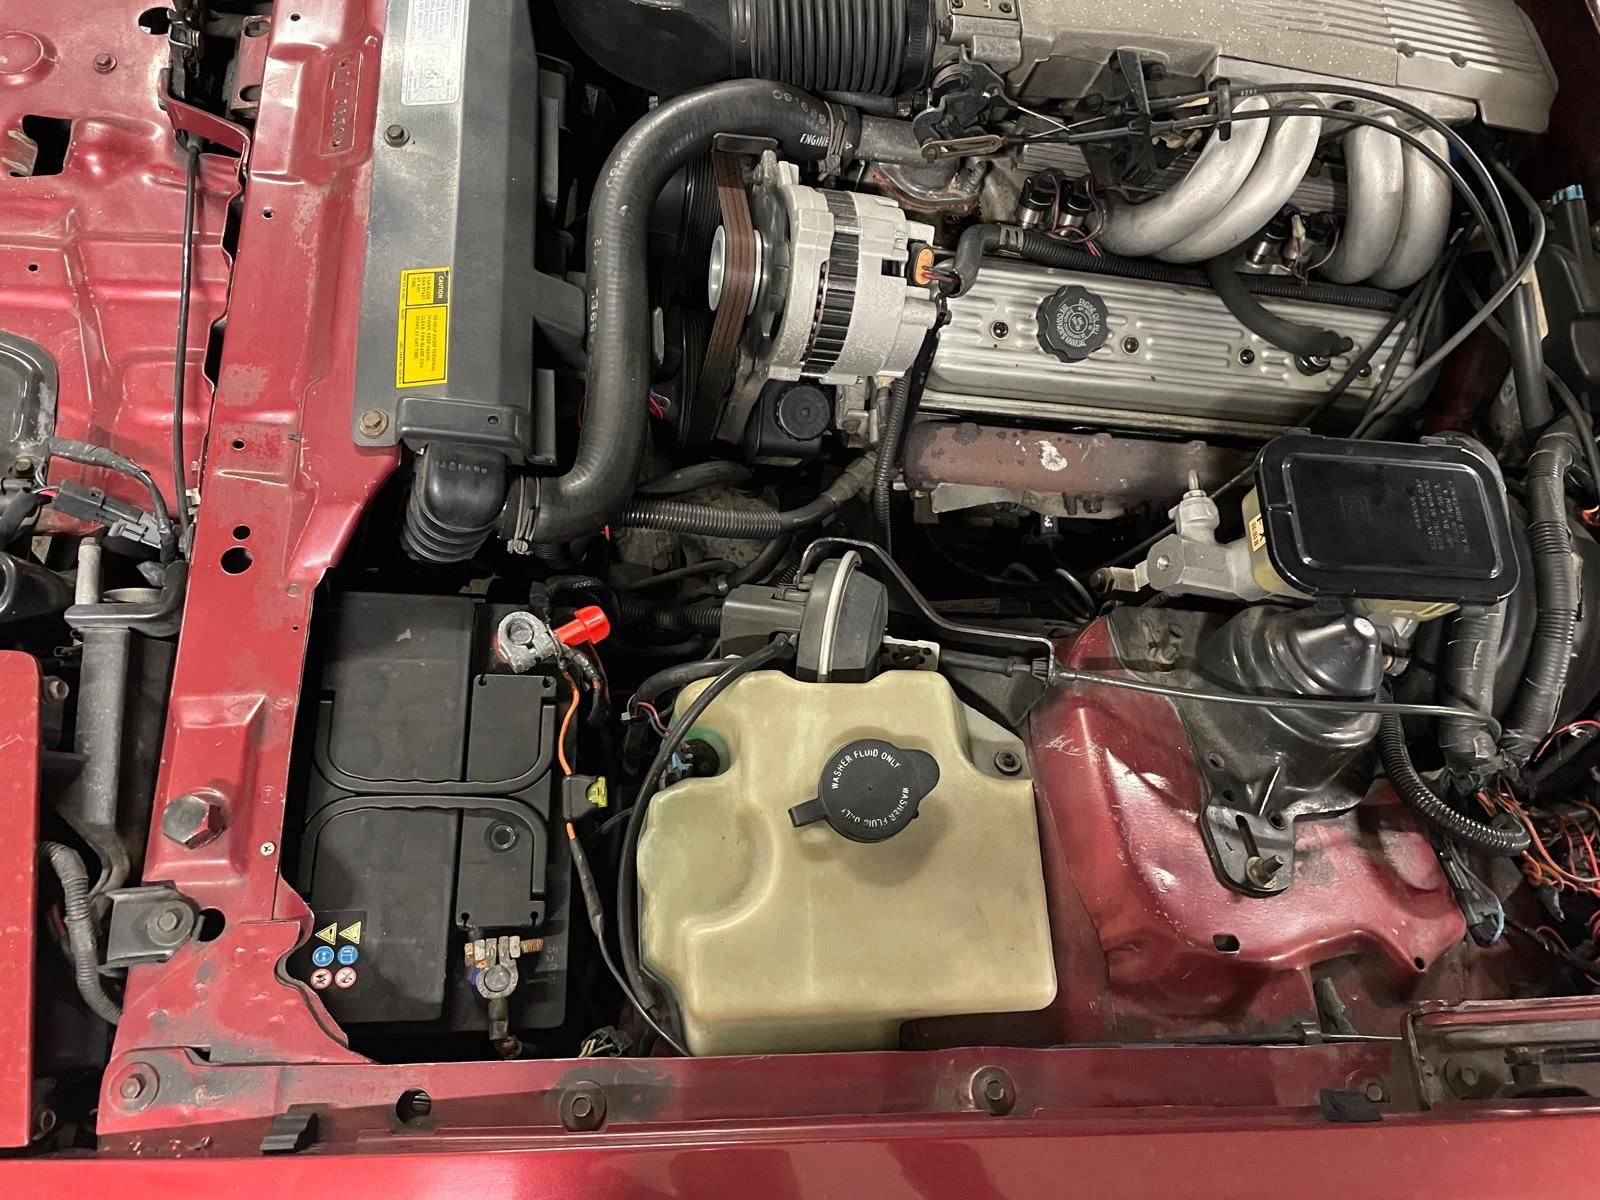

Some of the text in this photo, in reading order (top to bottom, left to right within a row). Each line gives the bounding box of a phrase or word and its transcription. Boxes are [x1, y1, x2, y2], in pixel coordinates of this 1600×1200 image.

[800, 134, 829, 147] ENGINE
[1065, 336, 1087, 347] MANUAL
[1410, 496, 1421, 529] WARNNG
[1424, 480, 1436, 516] REMOVNG
[1449, 480, 1462, 521] CONTANER
[831, 749, 902, 790] WASHER FLUID ONLY
[841, 787, 910, 828] WASHER FLUID ONLY
